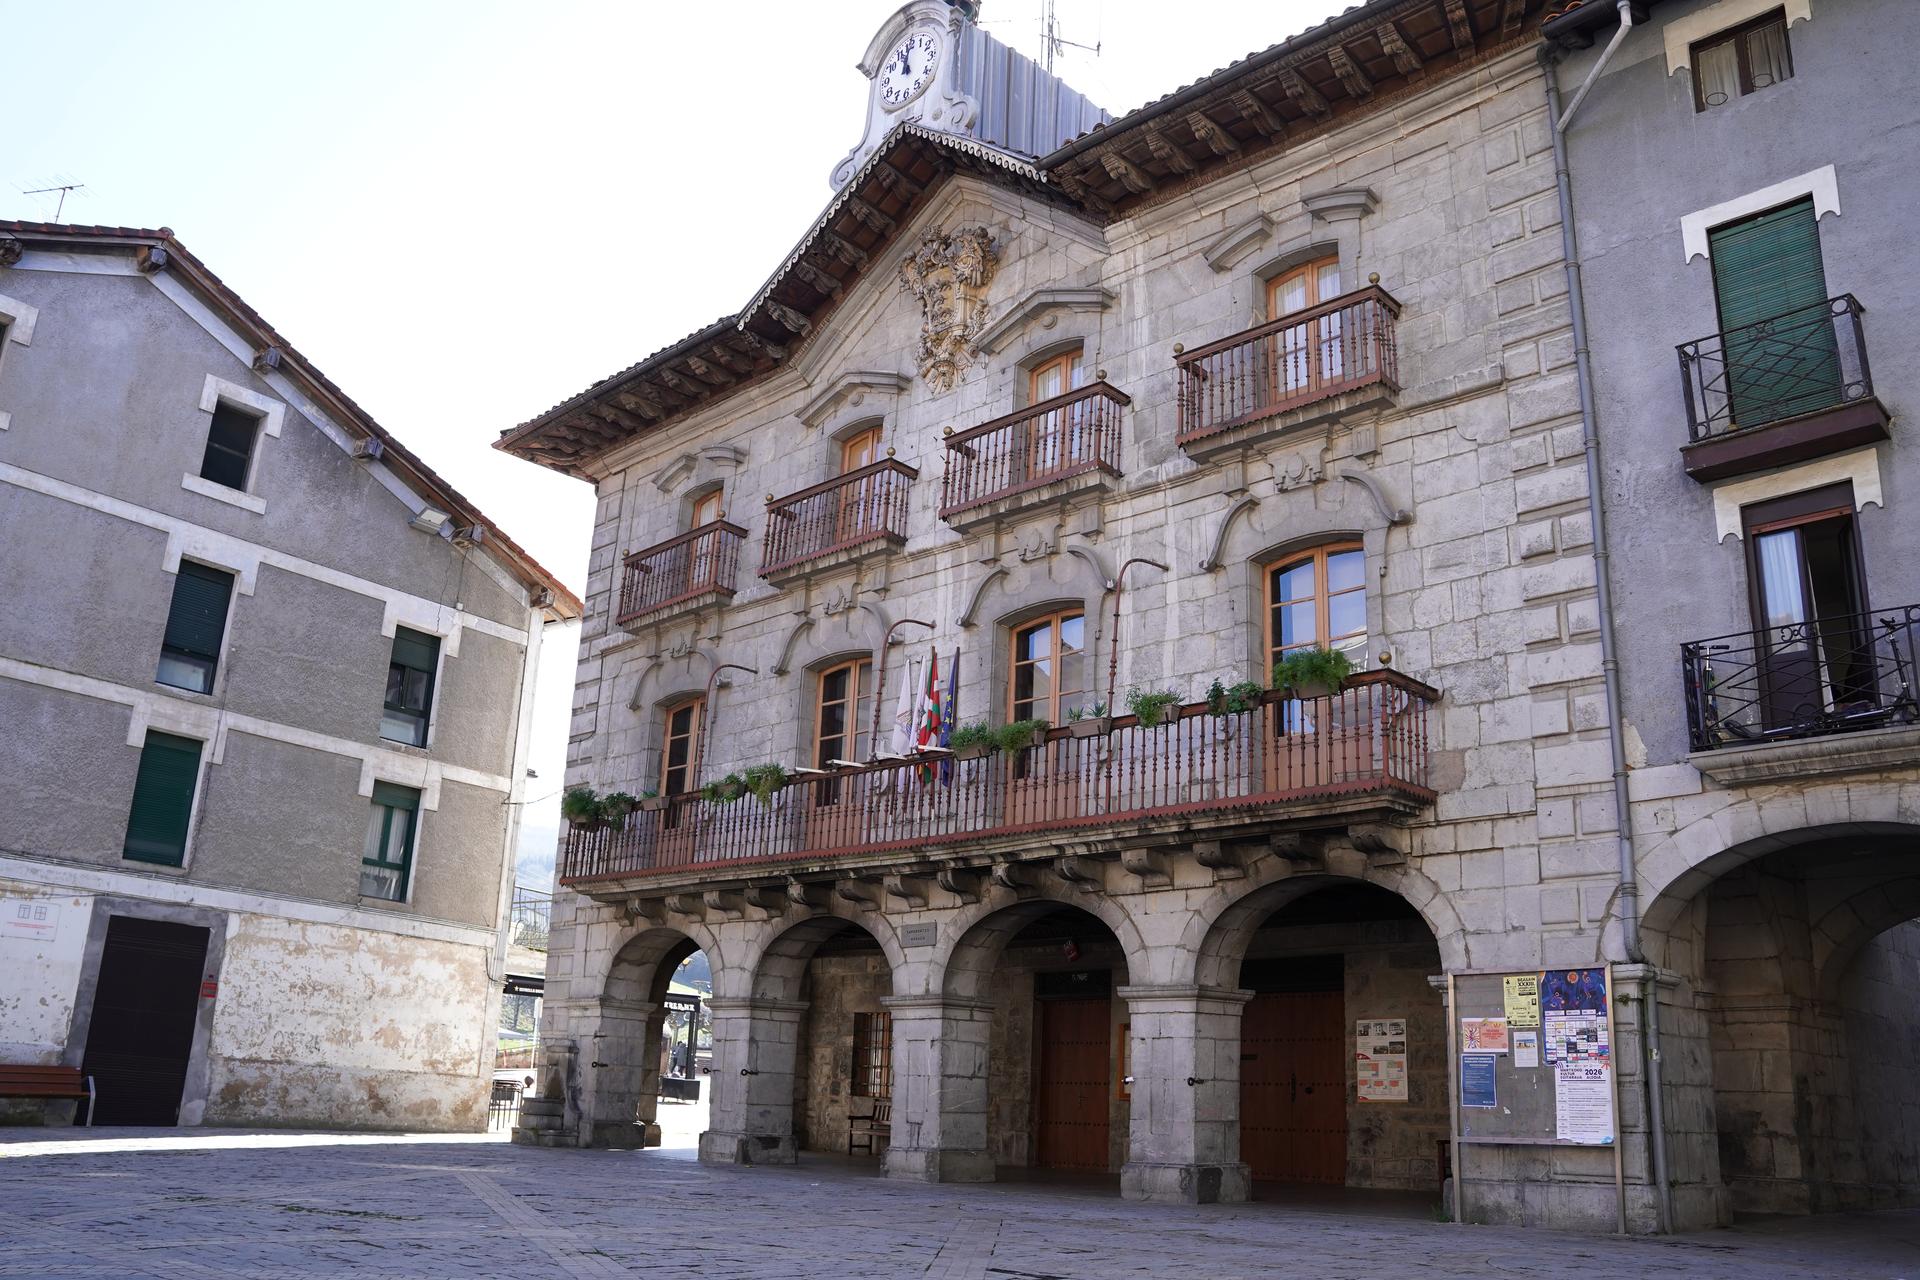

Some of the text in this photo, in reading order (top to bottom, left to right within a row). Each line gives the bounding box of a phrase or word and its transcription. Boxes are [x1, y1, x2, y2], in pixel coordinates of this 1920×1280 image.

[918, 37, 922, 48] 1
[924, 40, 932, 52] 2
[926, 50, 934, 62] 3
[886, 62, 896, 74] 10
[922, 64, 932, 75] 4
[883, 76, 890, 88] 9
[913, 78, 921, 90] 5
[886, 86, 893, 98] 8
[894, 89, 901, 102] 7
[903, 87, 910, 100] 6
